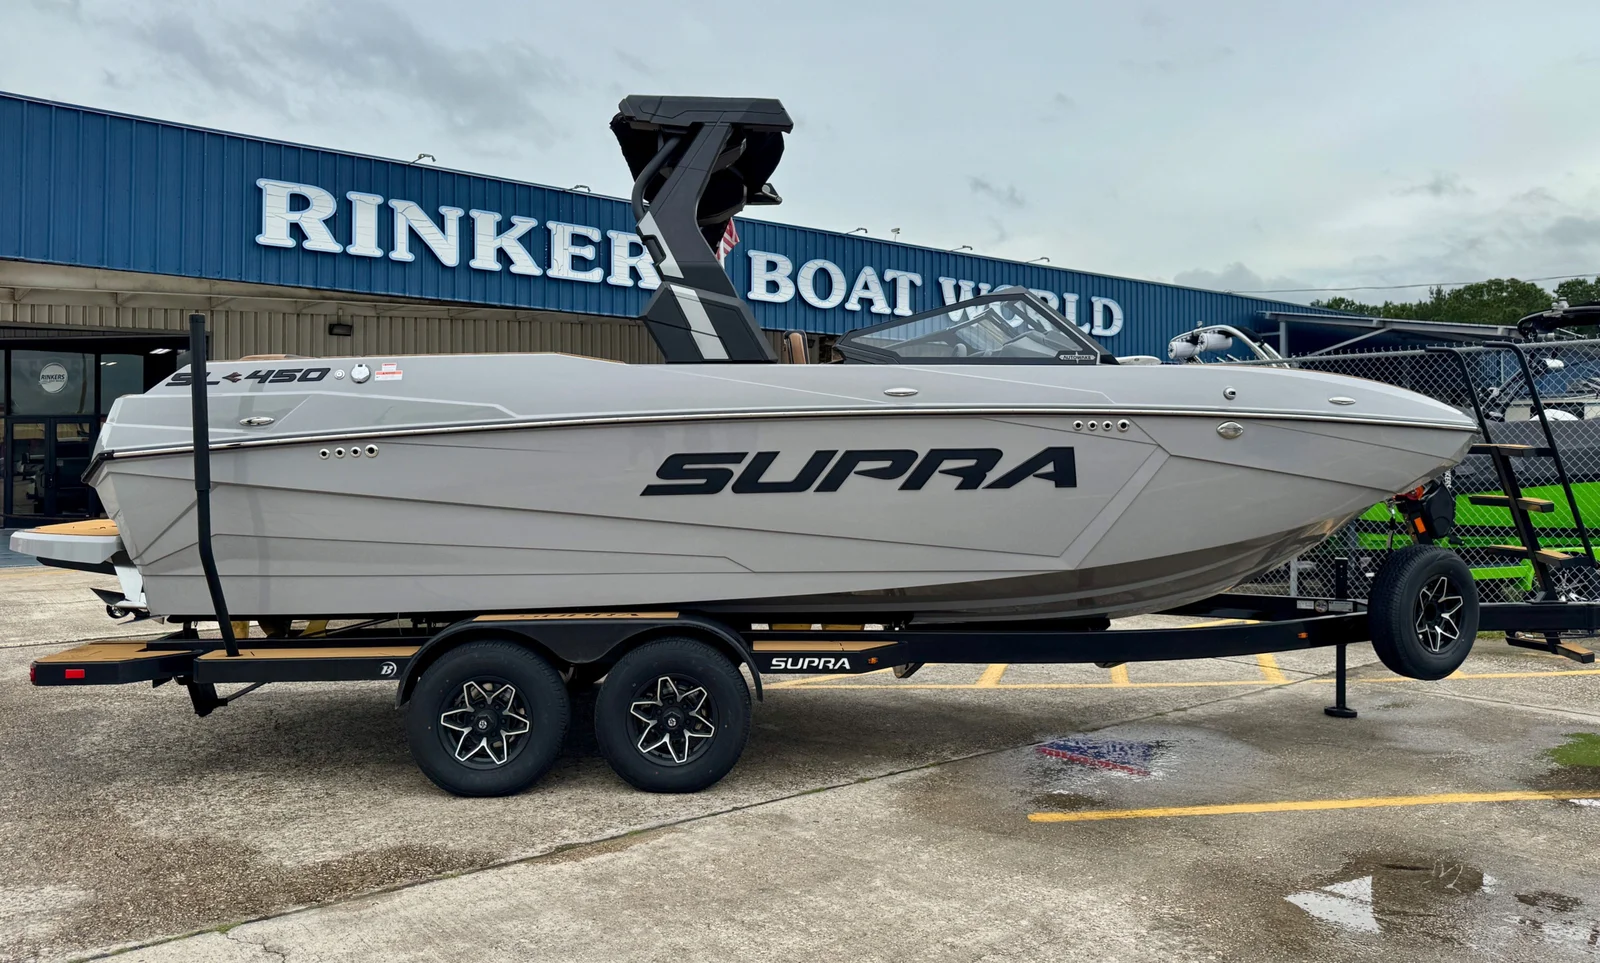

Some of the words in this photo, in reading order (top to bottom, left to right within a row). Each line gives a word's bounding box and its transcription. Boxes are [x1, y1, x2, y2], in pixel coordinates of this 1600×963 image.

[255, 178, 662, 290] RINKER
[747, 249, 922, 316] BOAT
[244, 368, 331, 383] 450
[640, 446, 1077, 496] SUPRA
[770, 657, 851, 670] SUPRA
